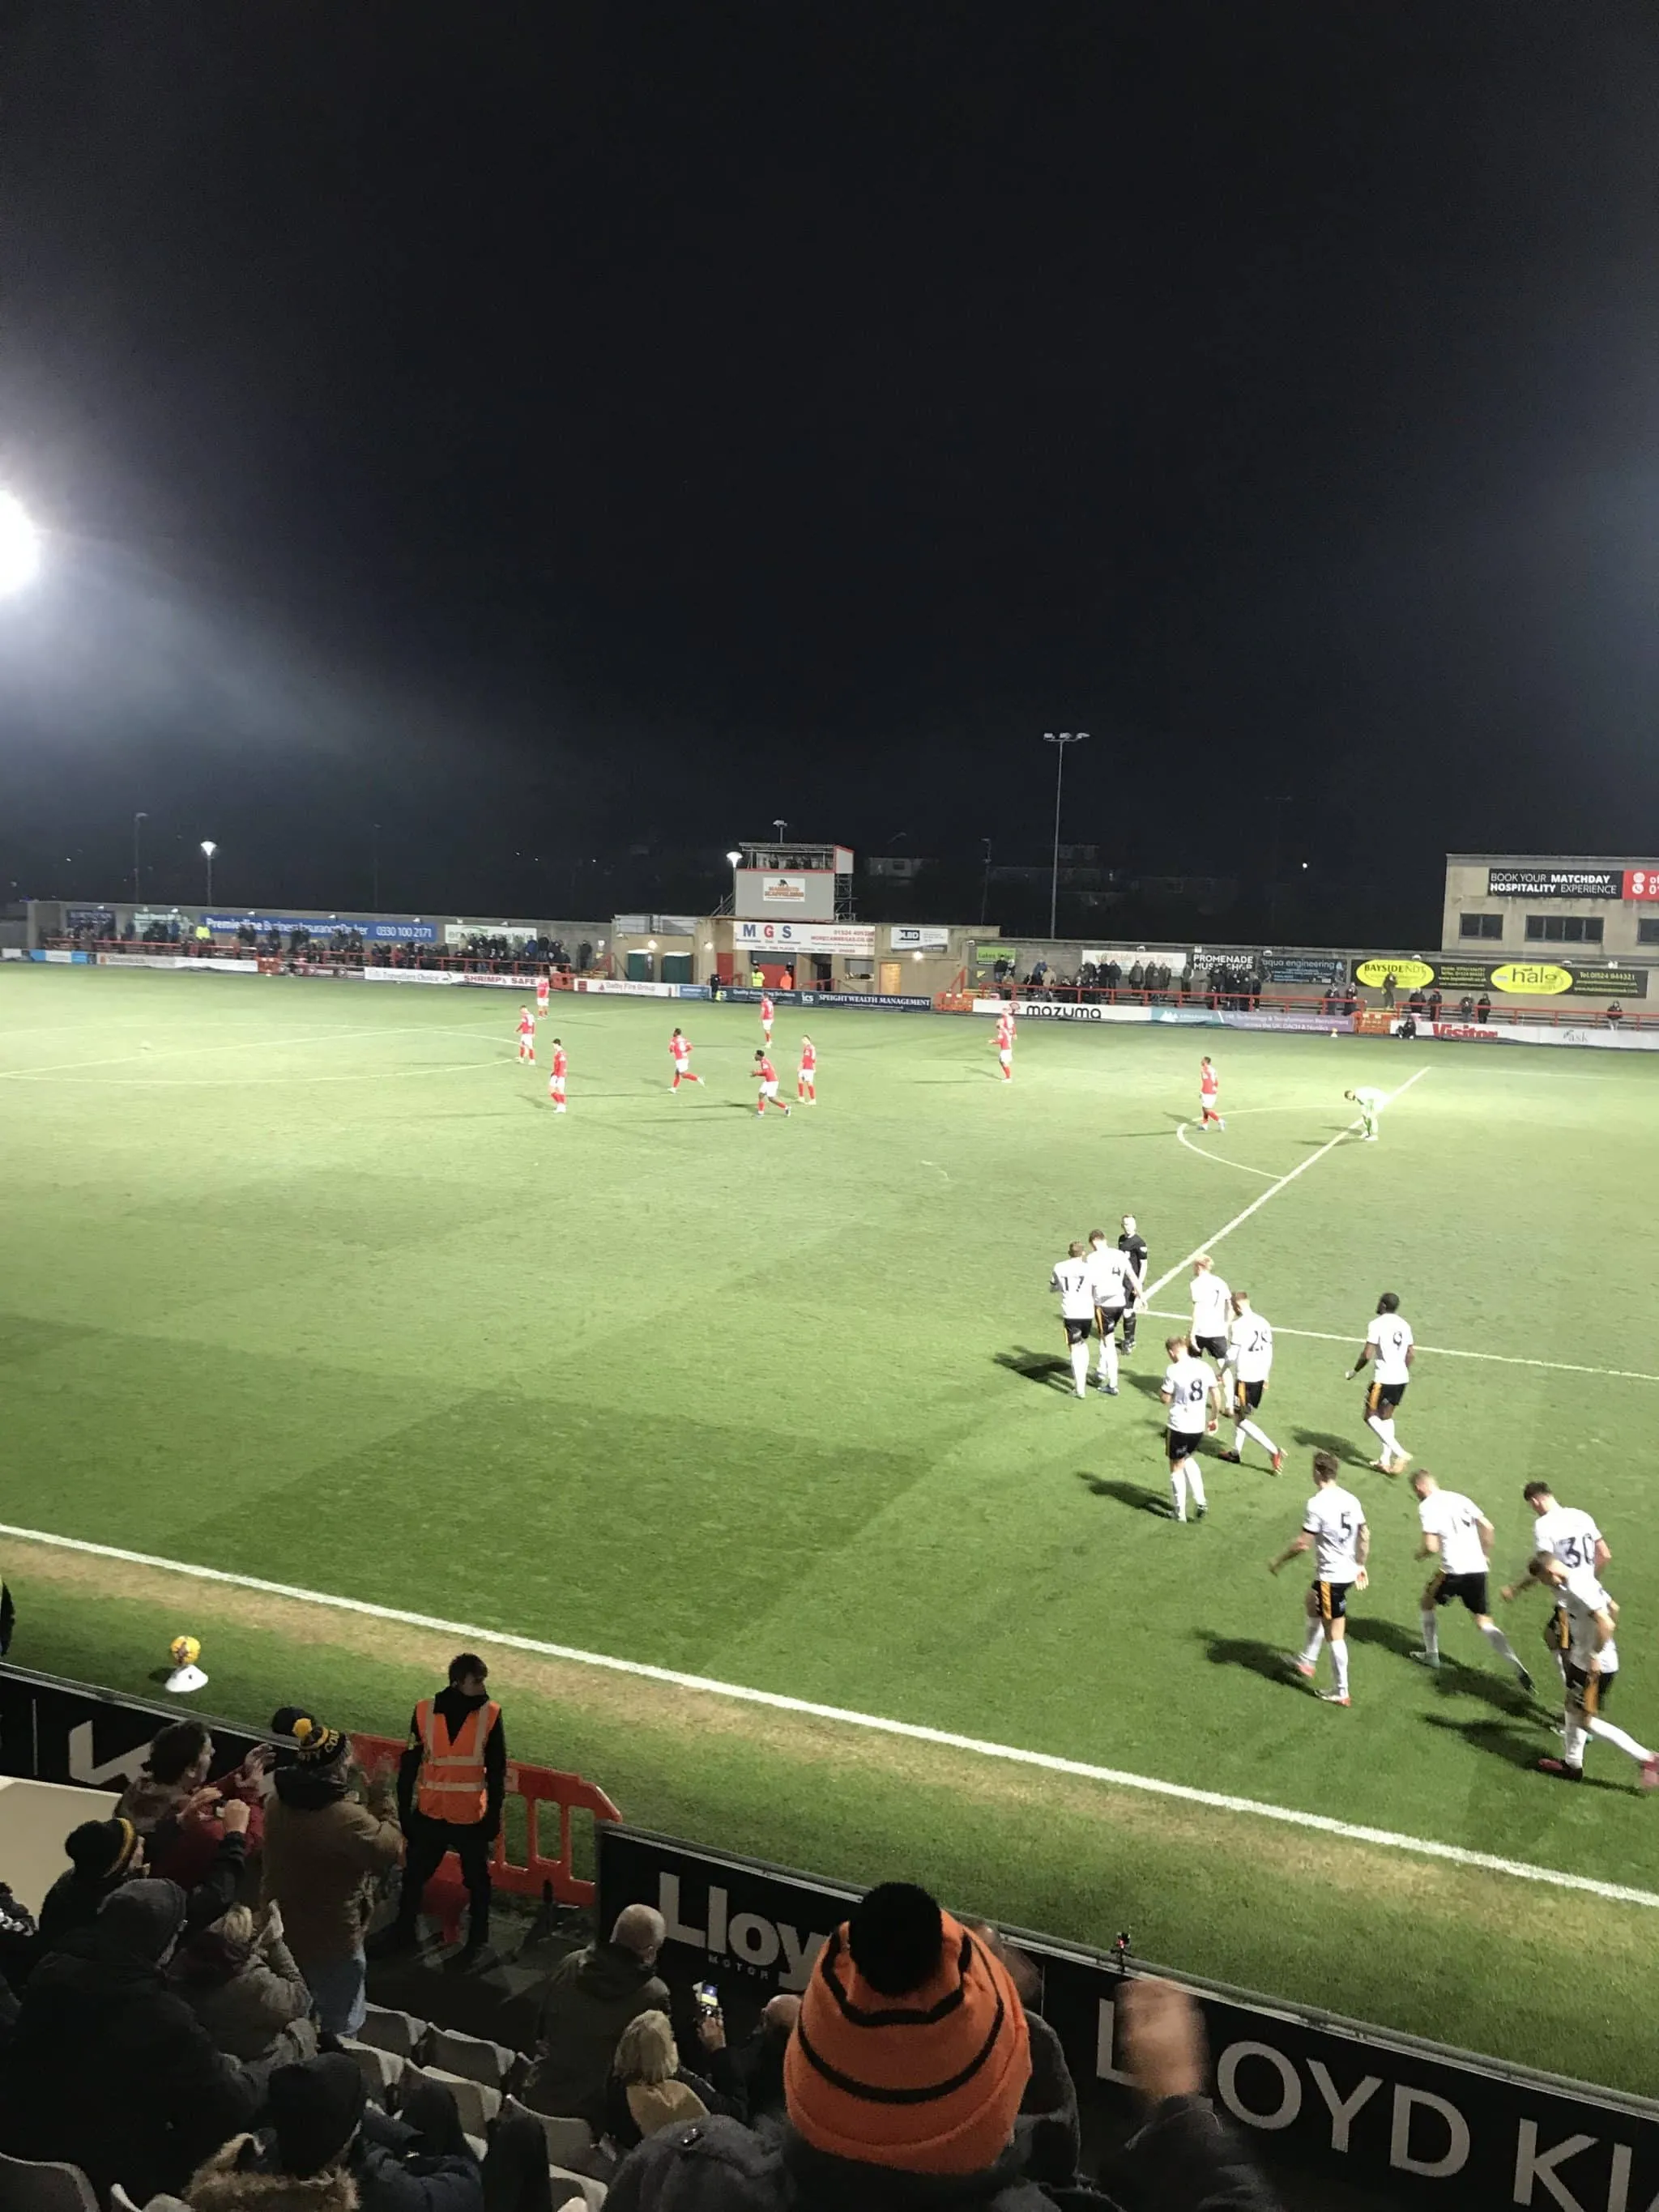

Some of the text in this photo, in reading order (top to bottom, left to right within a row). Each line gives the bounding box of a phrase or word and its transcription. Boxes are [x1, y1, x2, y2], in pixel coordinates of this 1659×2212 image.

[1491, 873, 1610, 884] BOOK YOUR MATCHDAY
[1491, 883, 1617, 895] HOSPITALITY EXPERIENCE
[398, 927, 412, 937] 100
[1193, 954, 1253, 964] PROMENADE
[1261, 958, 1335, 970] aqua engineering
[511, 977, 537, 985] SAFE
[819, 994, 847, 1002] SPEIGHT
[848, 995, 877, 1004] WEALTH
[880, 997, 931, 1006] MANAGEMENT
[1026, 1004, 1102, 1019] mazuma
[1432, 1023, 1498, 1038] Visitor
[1061, 1275, 1085, 1293] 17
[1392, 1331, 1403, 1347] 9
[1189, 1377, 1204, 1402] 8
[1338, 1511, 1353, 1544] 5
[1558, 1532, 1594, 1569] 30
[659, 1872, 834, 1993] Lloy
[709, 1953, 769, 1980] MOTOR
[1096, 1997, 1659, 2212] LOYD KI
